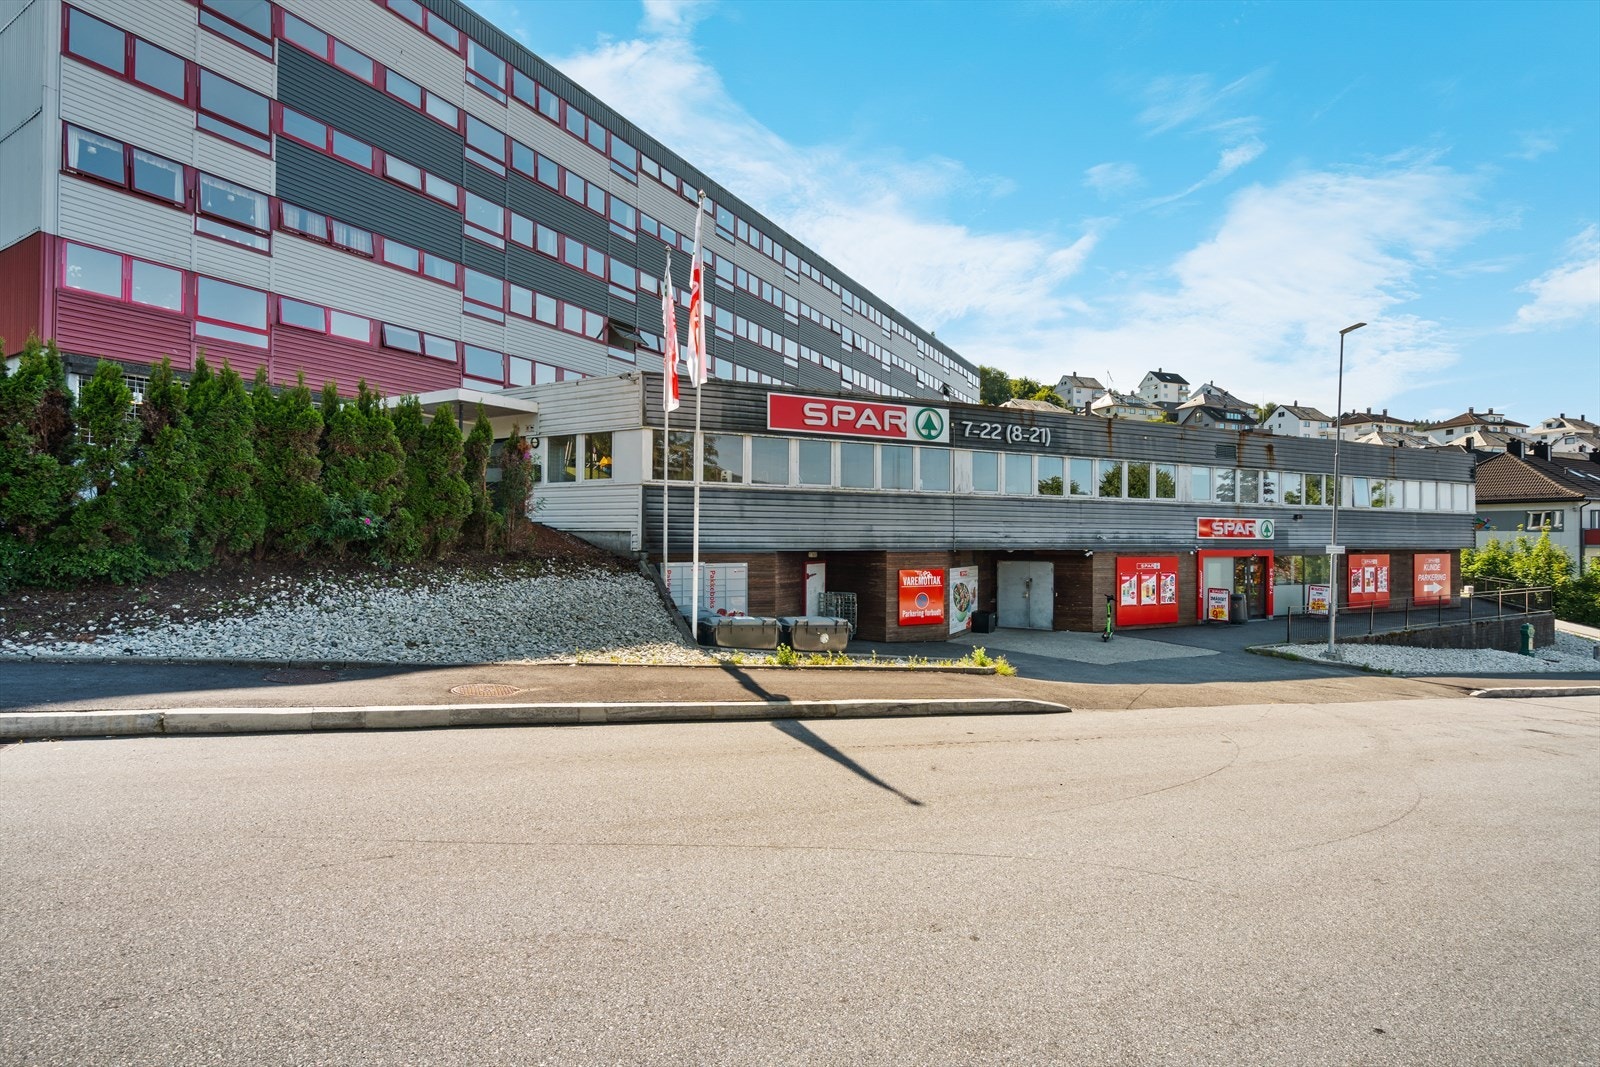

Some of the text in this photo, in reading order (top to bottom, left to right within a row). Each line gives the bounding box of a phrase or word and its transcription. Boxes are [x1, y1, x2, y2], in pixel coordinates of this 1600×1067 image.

[803, 402, 907, 432] SPAR
[961, 421, 1051, 447] 7-22 (8-21)
[1212, 522, 1256, 535] SPAR
[1424, 563, 1441, 571] KUNDE
[902, 575, 942, 586] VAREMOTTAK
[1417, 574, 1447, 582] PARKERING
[902, 609, 925, 618] Parkering
